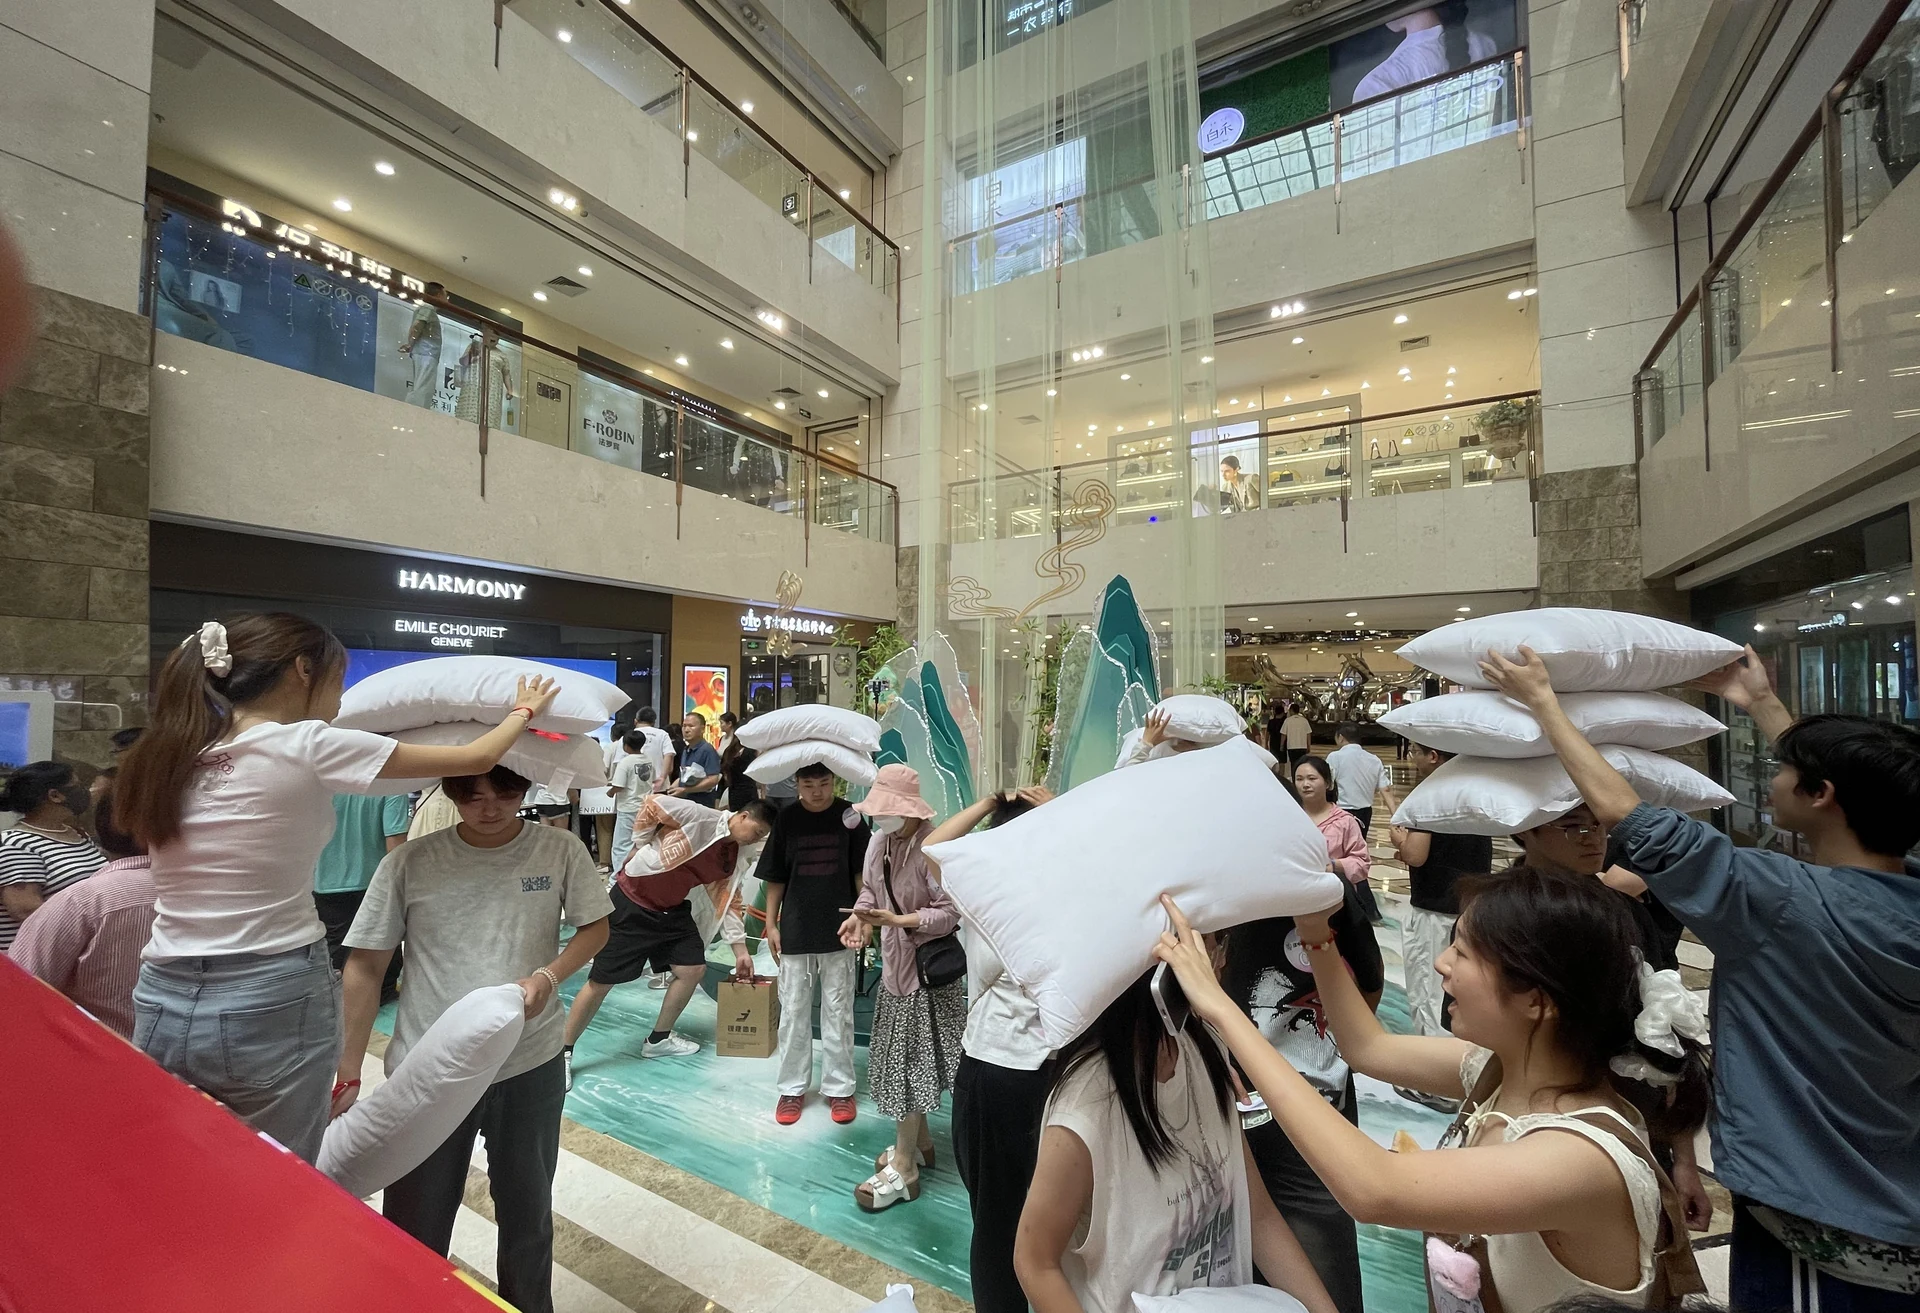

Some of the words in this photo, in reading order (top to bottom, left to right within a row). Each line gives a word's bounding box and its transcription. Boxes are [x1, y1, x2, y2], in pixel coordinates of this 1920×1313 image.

[399, 570, 526, 600] HARMONY
[394, 619, 438, 634] EMILE
[439, 623, 508, 638] CHOURIET
[431, 636, 474, 648] GENEVE
